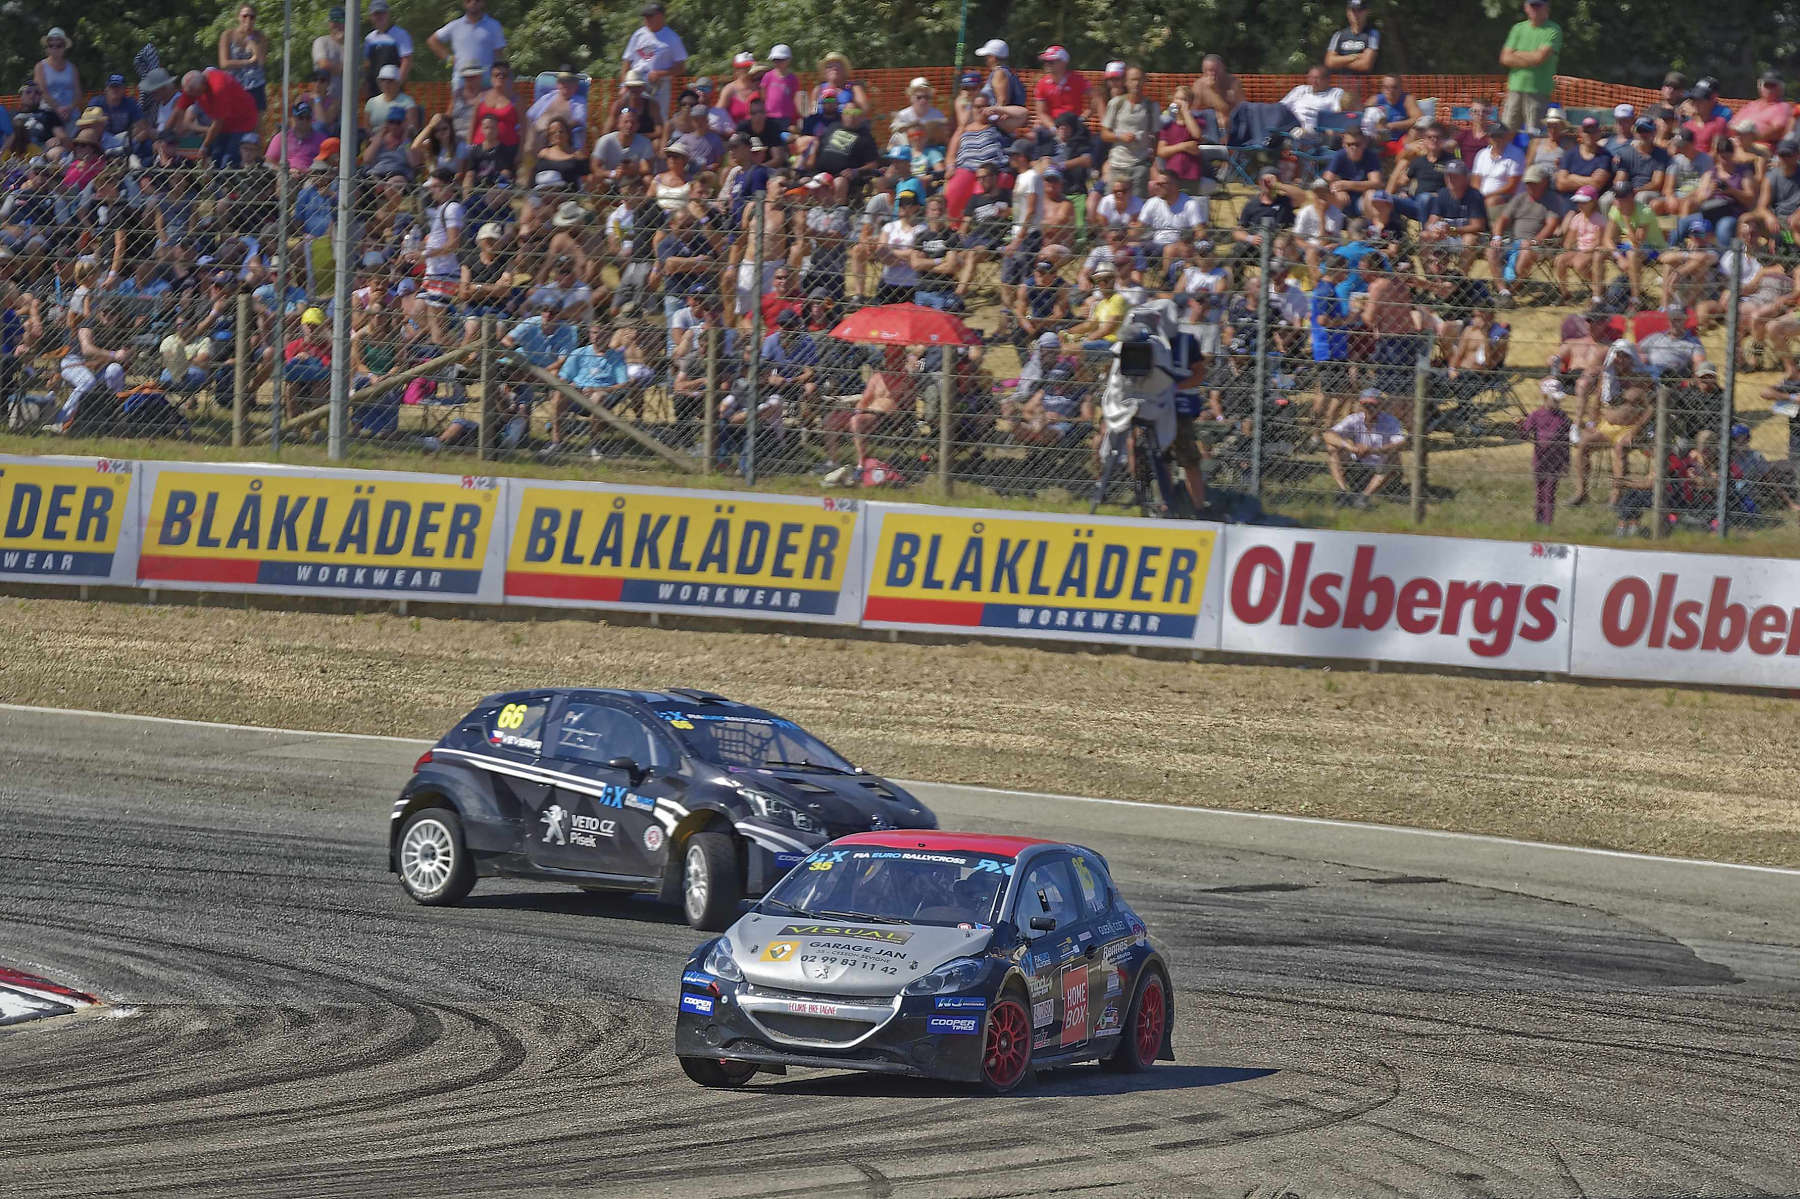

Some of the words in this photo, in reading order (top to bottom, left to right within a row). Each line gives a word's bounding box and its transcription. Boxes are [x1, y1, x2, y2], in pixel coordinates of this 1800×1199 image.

[0, 469, 114, 542] DER
[157, 479, 482, 559] BLÅKLÄDER
[524, 496, 840, 580] BLÅKLÄDER
[4, 552, 73, 571] WEAR
[885, 522, 1198, 603] BLÅKLÄDER
[296, 565, 443, 587] WORKWEAR
[658, 583, 802, 608] WORKWEAR
[1230, 541, 1561, 657] Olsbergs
[1017, 607, 1161, 632] WORKWEAR
[497, 703, 528, 729] 66
[571, 814, 600, 831] VETO
[600, 819, 616, 833] CZ
[809, 862, 834, 871] 35
[902, 853, 967, 865] RALLYCROSS
[787, 925, 903, 941] VISUAL
[809, 941, 873, 953] GARAGE
[875, 949, 907, 960] JAN
[800, 955, 816, 963] 02
[821, 956, 837, 964] 99
[840, 958, 856, 966] 83
[861, 961, 875, 971] 11
[881, 966, 898, 975] 42
[1067, 983, 1086, 1008] HOME
[931, 1019, 975, 1027] COOPER
[1065, 1004, 1087, 1029] BOX
